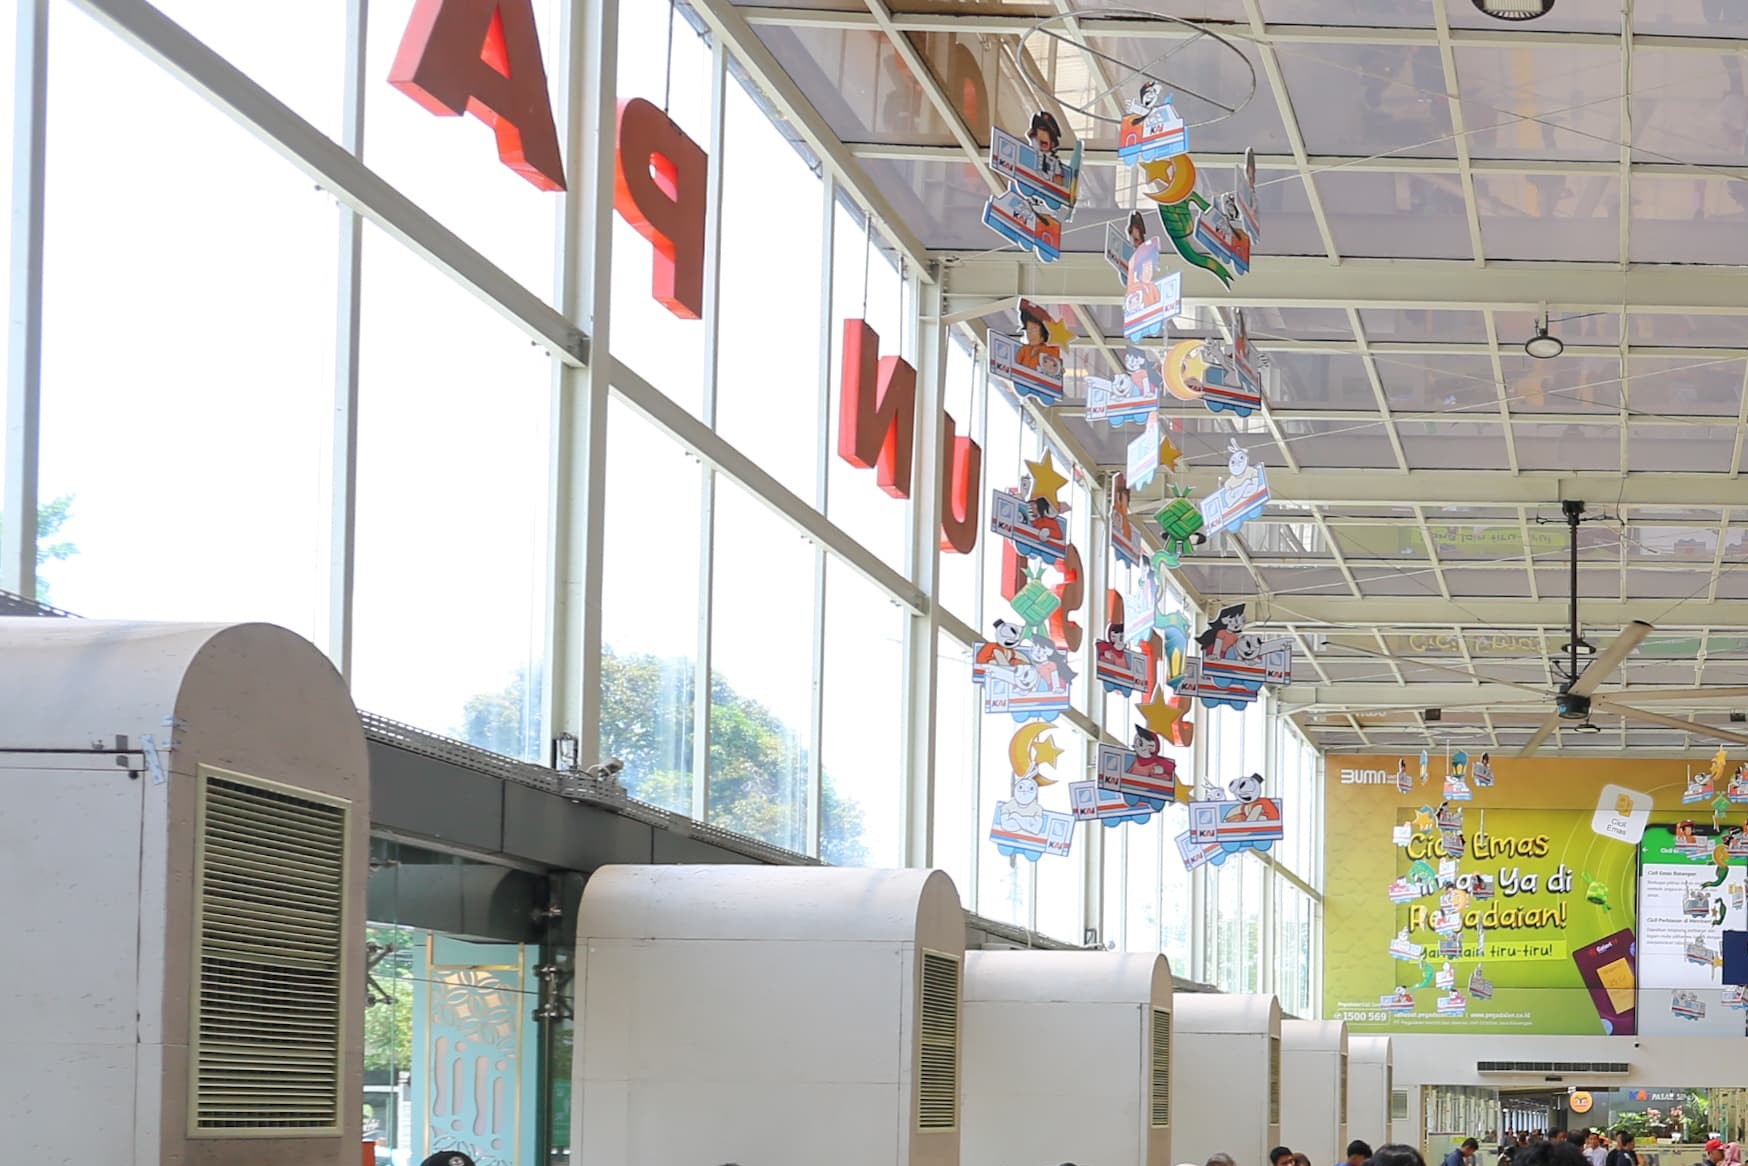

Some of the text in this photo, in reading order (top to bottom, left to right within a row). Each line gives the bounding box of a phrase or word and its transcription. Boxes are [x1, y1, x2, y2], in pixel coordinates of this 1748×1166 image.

[1105, 776, 1118, 785] KAI
[1606, 824, 1627, 836] Emas
[1472, 832, 1549, 860] Emas
[1499, 867, 1538, 896] Ya
[1547, 864, 1572, 893] di
[1343, 1012, 1366, 1022] 1500
[1368, 1012, 1387, 1022] 569
